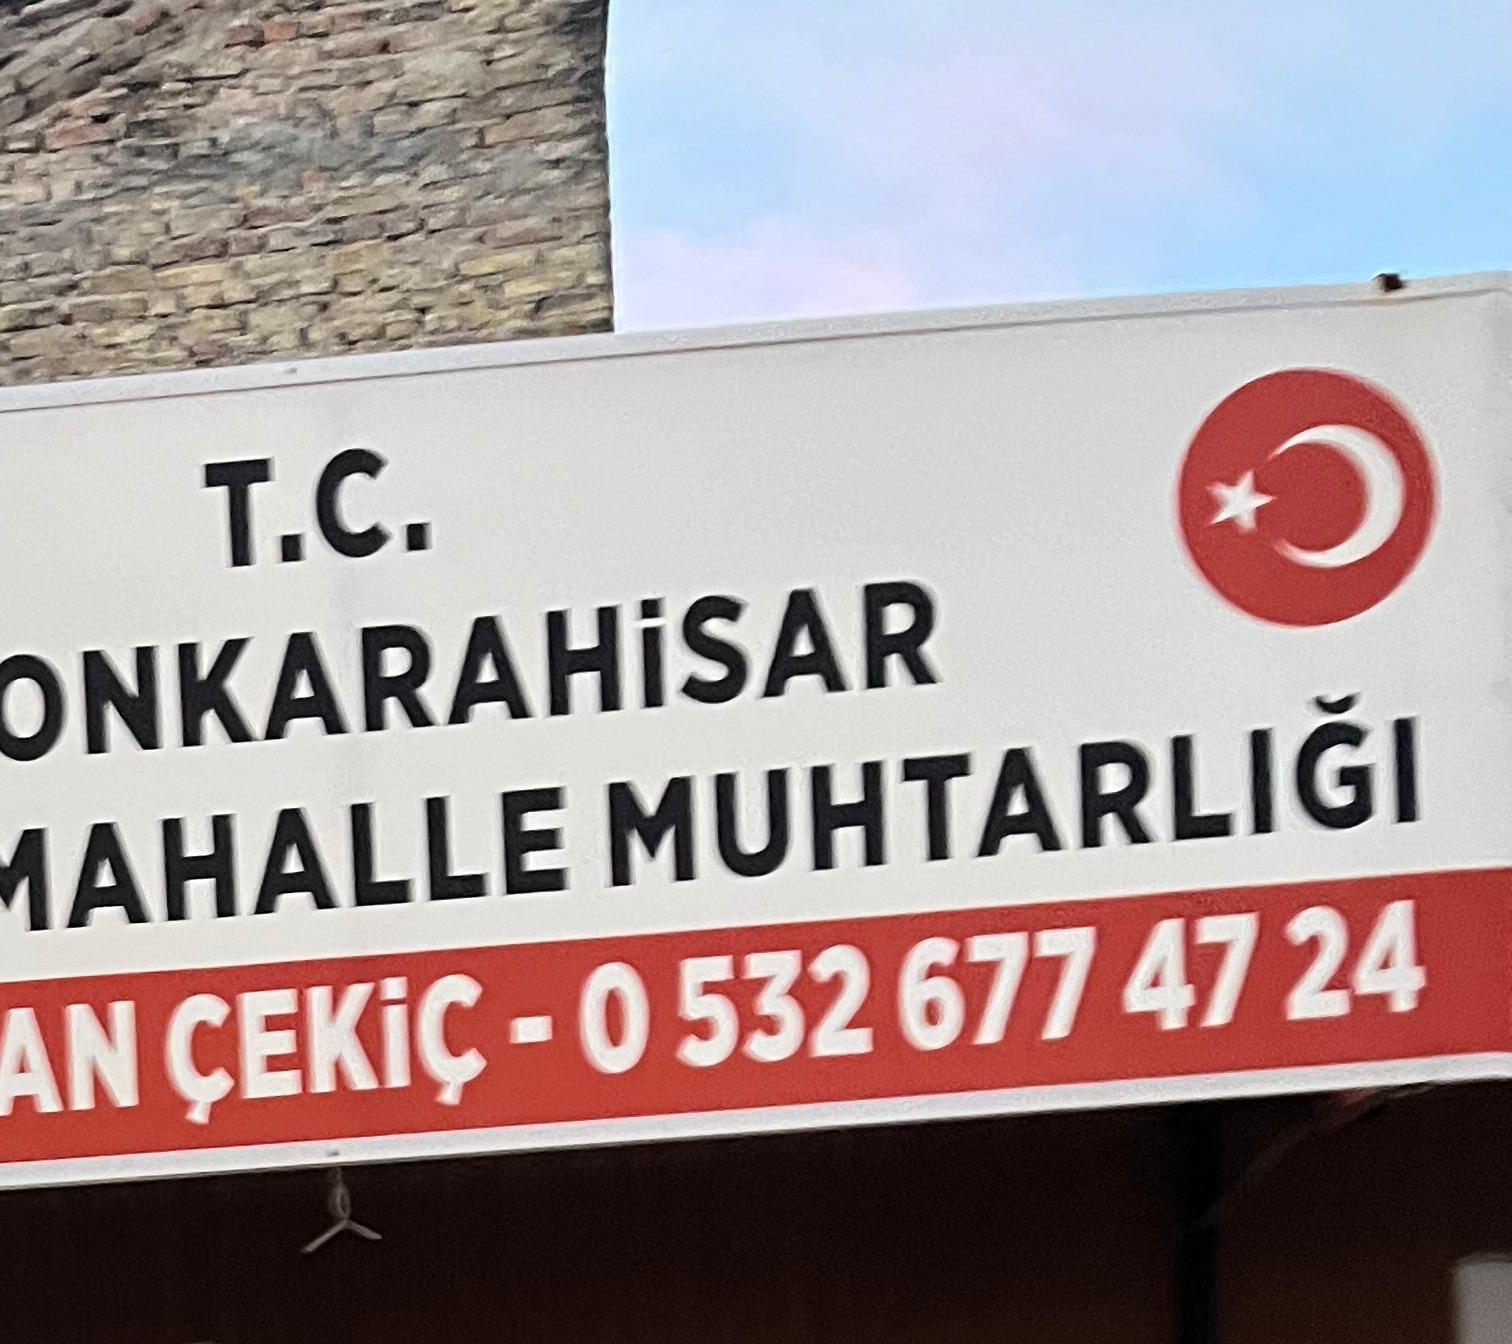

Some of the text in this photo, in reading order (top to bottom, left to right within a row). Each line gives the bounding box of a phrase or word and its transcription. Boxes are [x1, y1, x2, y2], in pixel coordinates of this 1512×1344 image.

[202, 446, 431, 569] T.C.
[606, 694, 1419, 888] MUHTARLIĞI
[509, 1014, 554, 1045] -
[578, 960, 650, 1075] 0
[675, 943, 874, 1068] 532
[897, 925, 1097, 1052] 677
[1122, 911, 1259, 1031] 47
[1284, 898, 1427, 1022] 24
